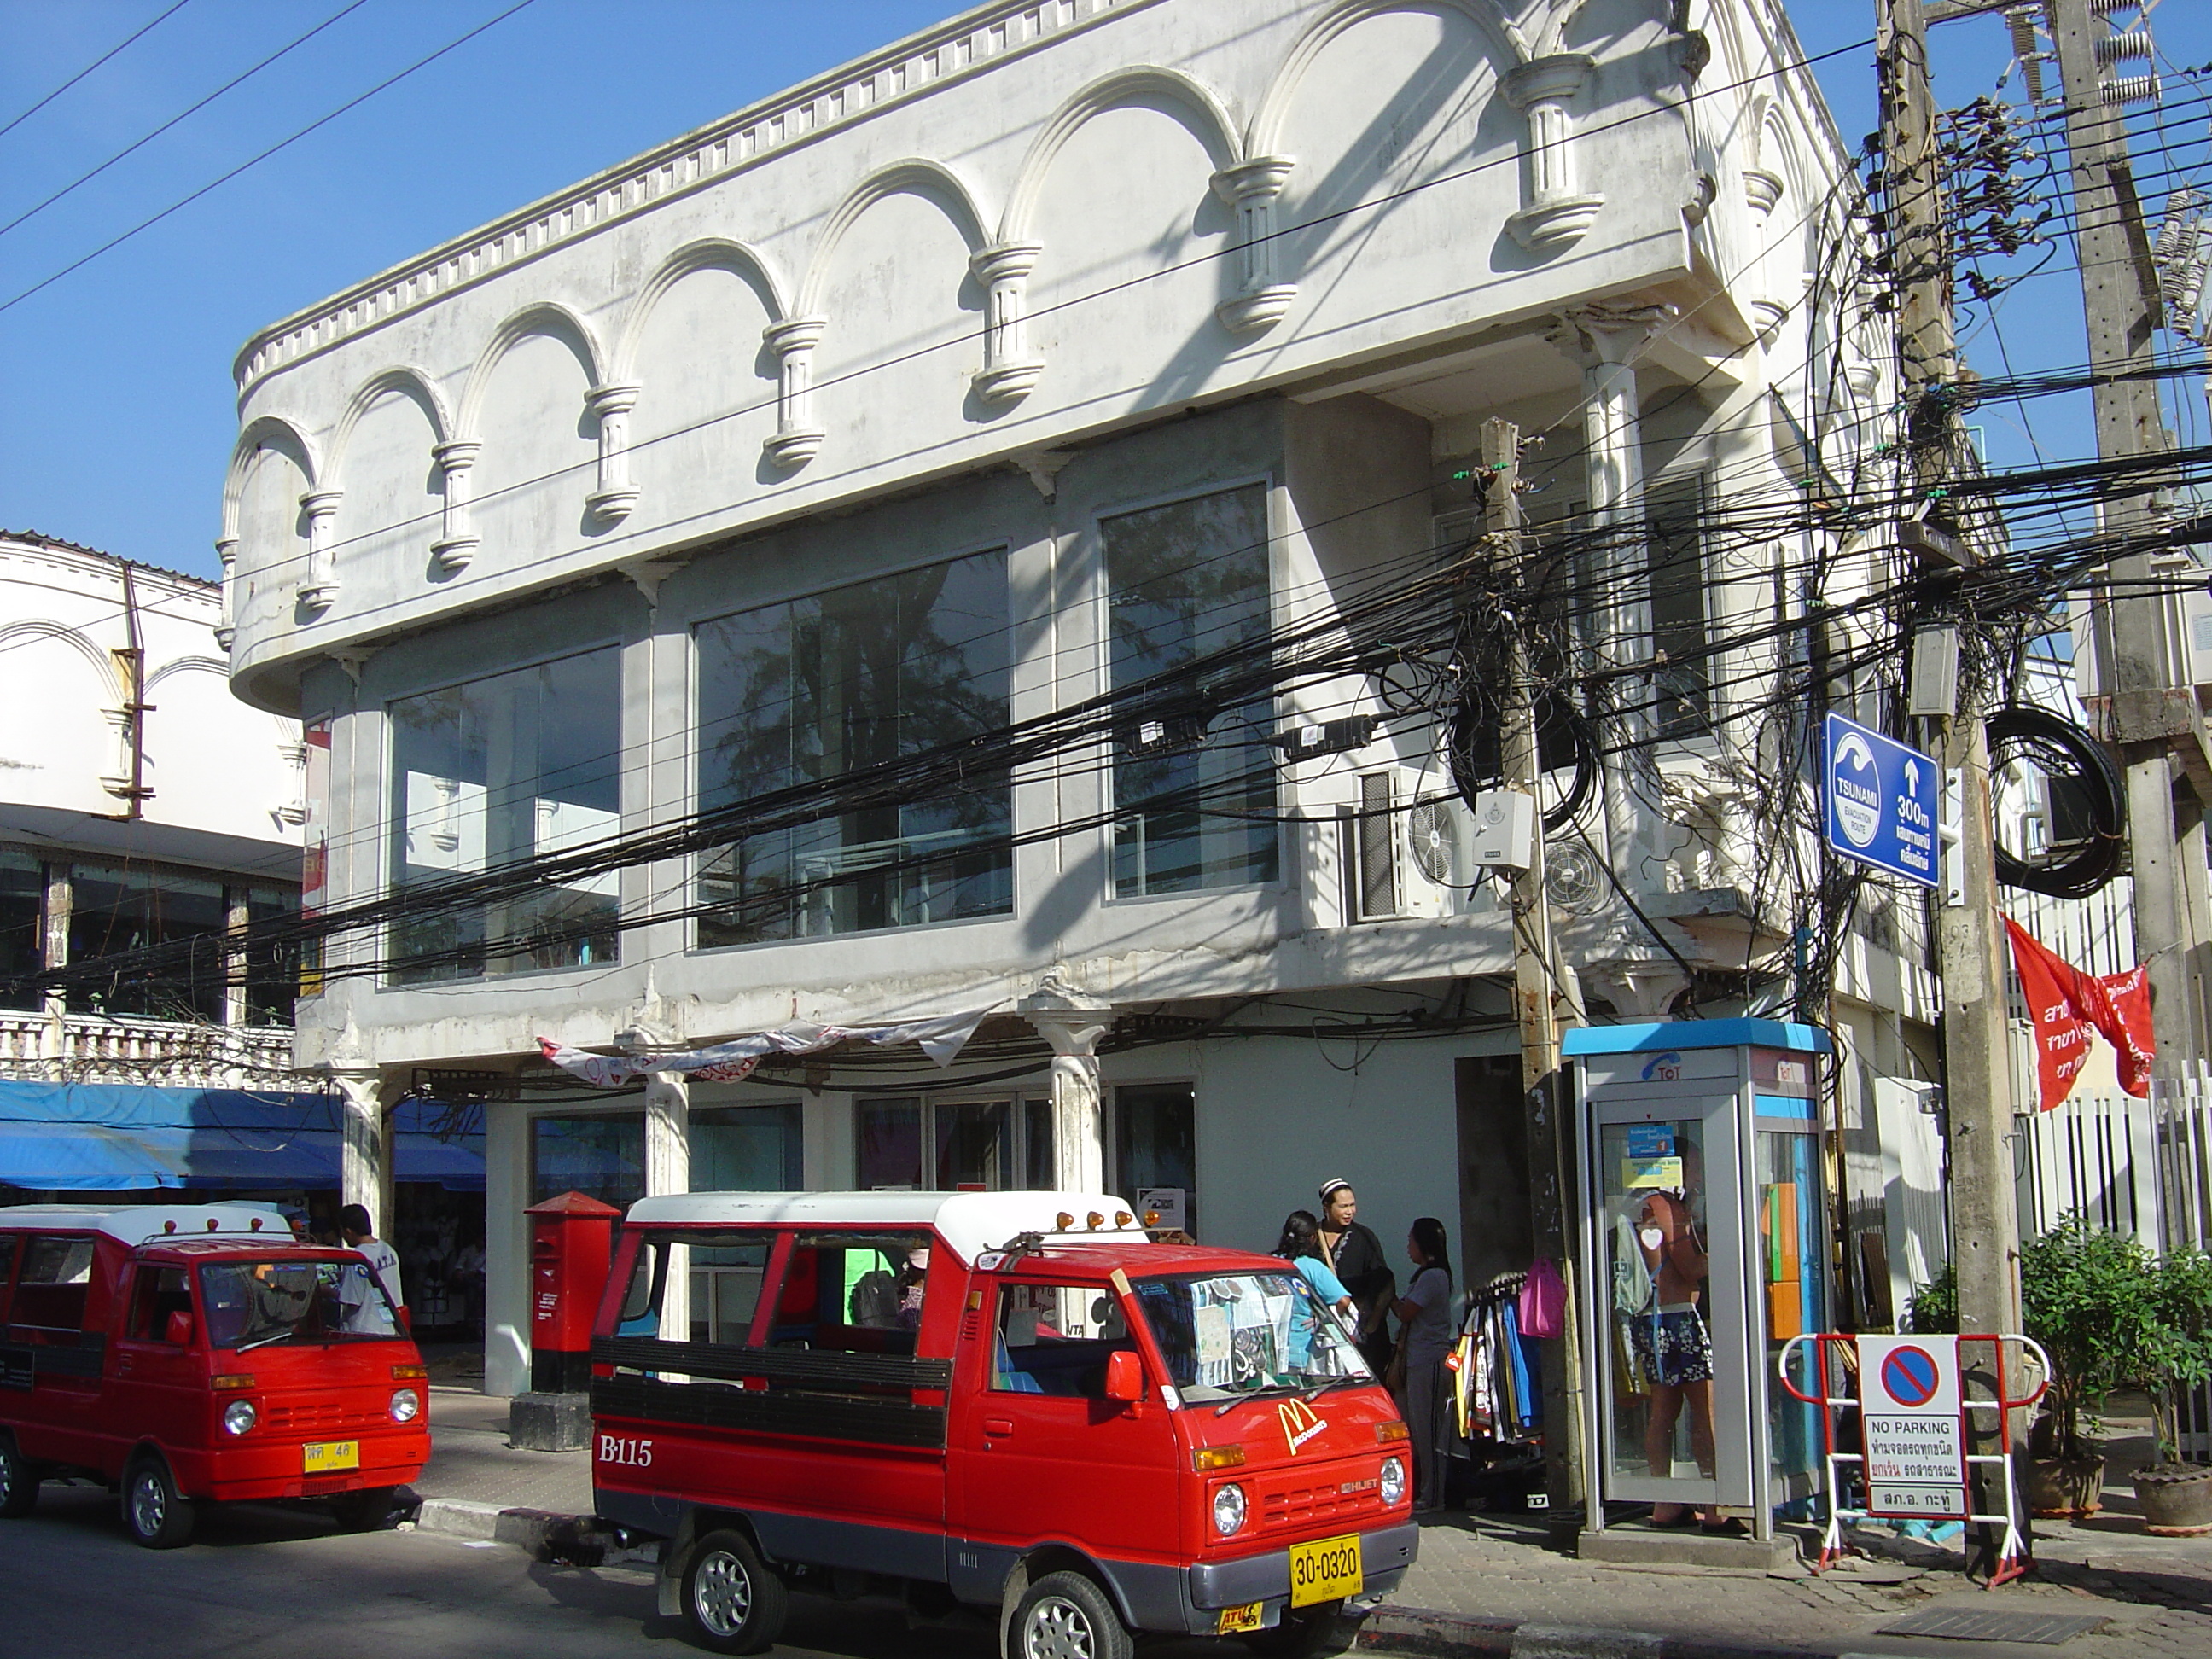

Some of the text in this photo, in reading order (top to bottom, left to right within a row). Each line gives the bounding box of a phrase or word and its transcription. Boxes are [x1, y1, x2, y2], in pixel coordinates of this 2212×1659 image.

[1837, 777, 1877, 808] TSUNAMI
[1844, 806, 1872, 825] EVACUATION
[1897, 795, 1929, 829] 300m
[1850, 820, 1866, 835] ROUTE
[1871, 1422, 1950, 1435] NO PARKING
[1871, 1438, 1953, 1461] ห้ามจอดรถทุกชนิด
[1871, 1459, 1958, 1478] ยกเว้น รถสาธารณะ
[1351, 1478, 1378, 1493] HIJET
[1295, 1547, 1357, 1586] 30-0320
